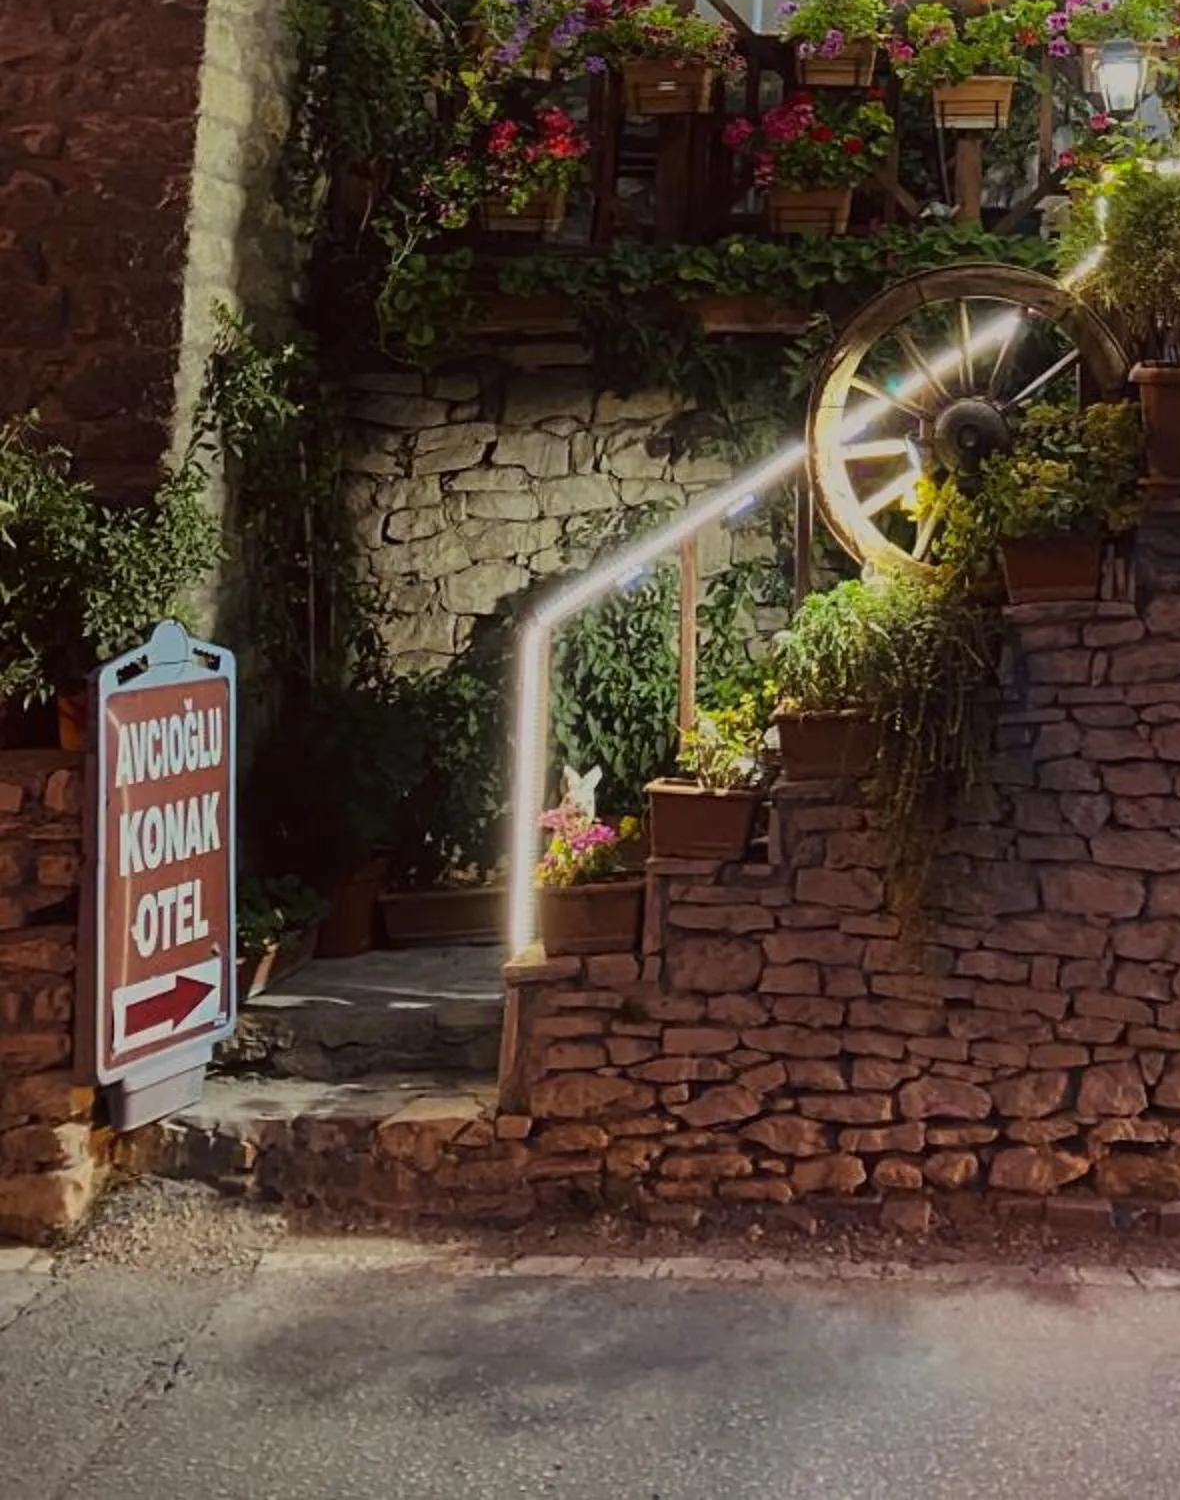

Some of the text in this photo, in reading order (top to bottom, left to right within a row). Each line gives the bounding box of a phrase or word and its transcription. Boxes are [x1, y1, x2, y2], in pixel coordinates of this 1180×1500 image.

[115, 697, 222, 788] AVCIOĞLU
[119, 791, 221, 877] KONAK
[134, 878, 209, 958] OTEL
